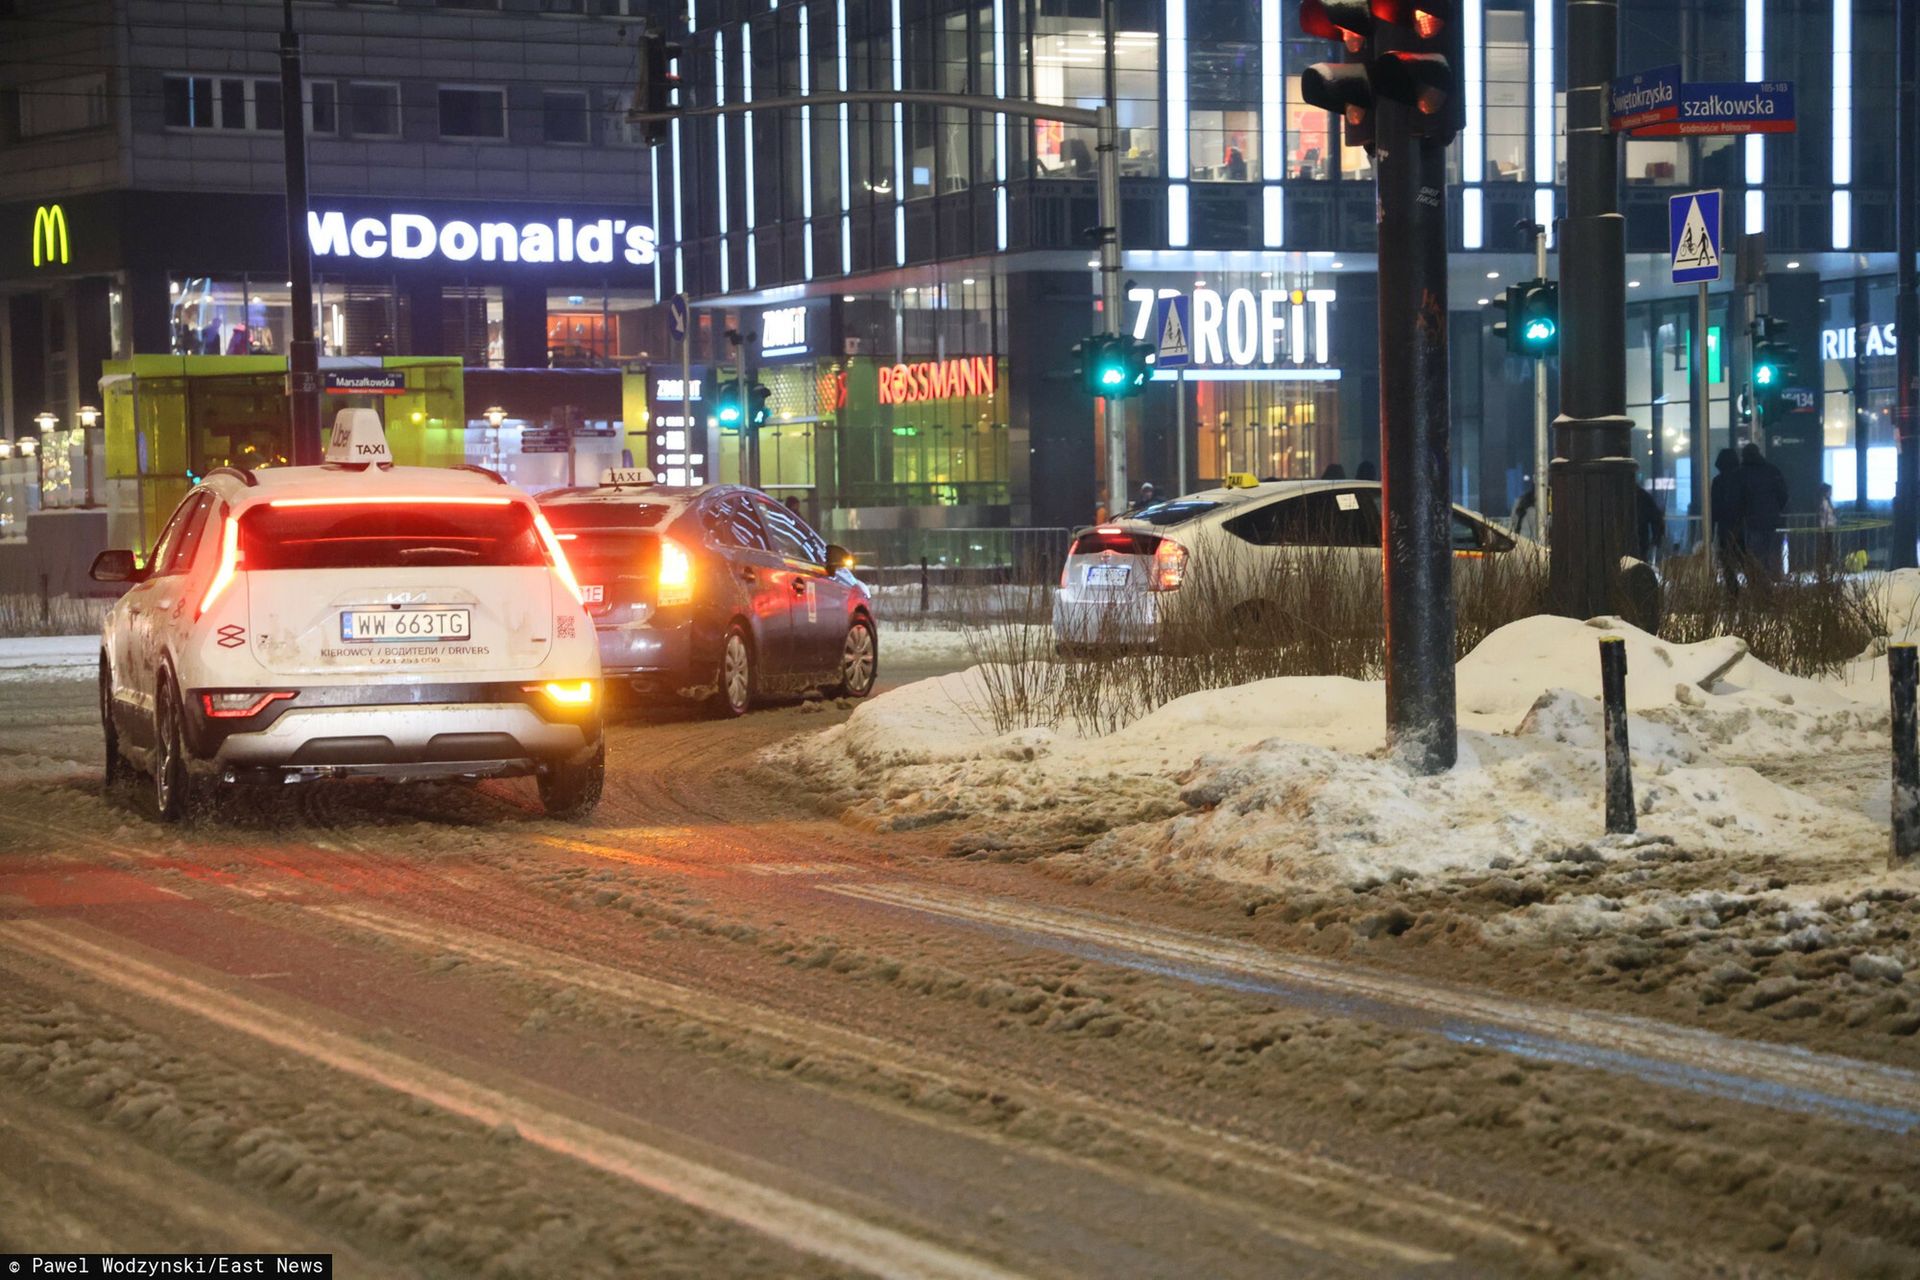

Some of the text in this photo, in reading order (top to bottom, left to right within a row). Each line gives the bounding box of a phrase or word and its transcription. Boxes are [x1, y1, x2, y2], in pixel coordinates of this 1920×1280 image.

[1613, 80, 1673, 115] Świętokrzyska
[1682, 94, 1775, 117] szałkowska
[307, 211, 656, 265] McDonald's
[1128, 288, 1337, 365] ZROFiT
[879, 356, 994, 404] ROSSMANN
[355, 444, 386, 455] TAXI
[608, 472, 642, 482] TAXI
[358, 613, 463, 636] WW 663TG
[320, 648, 373, 658] KIEROWCY
[385, 646, 438, 657] ВОДИТЕЛИ
[448, 646, 490, 656] DRIVERS
